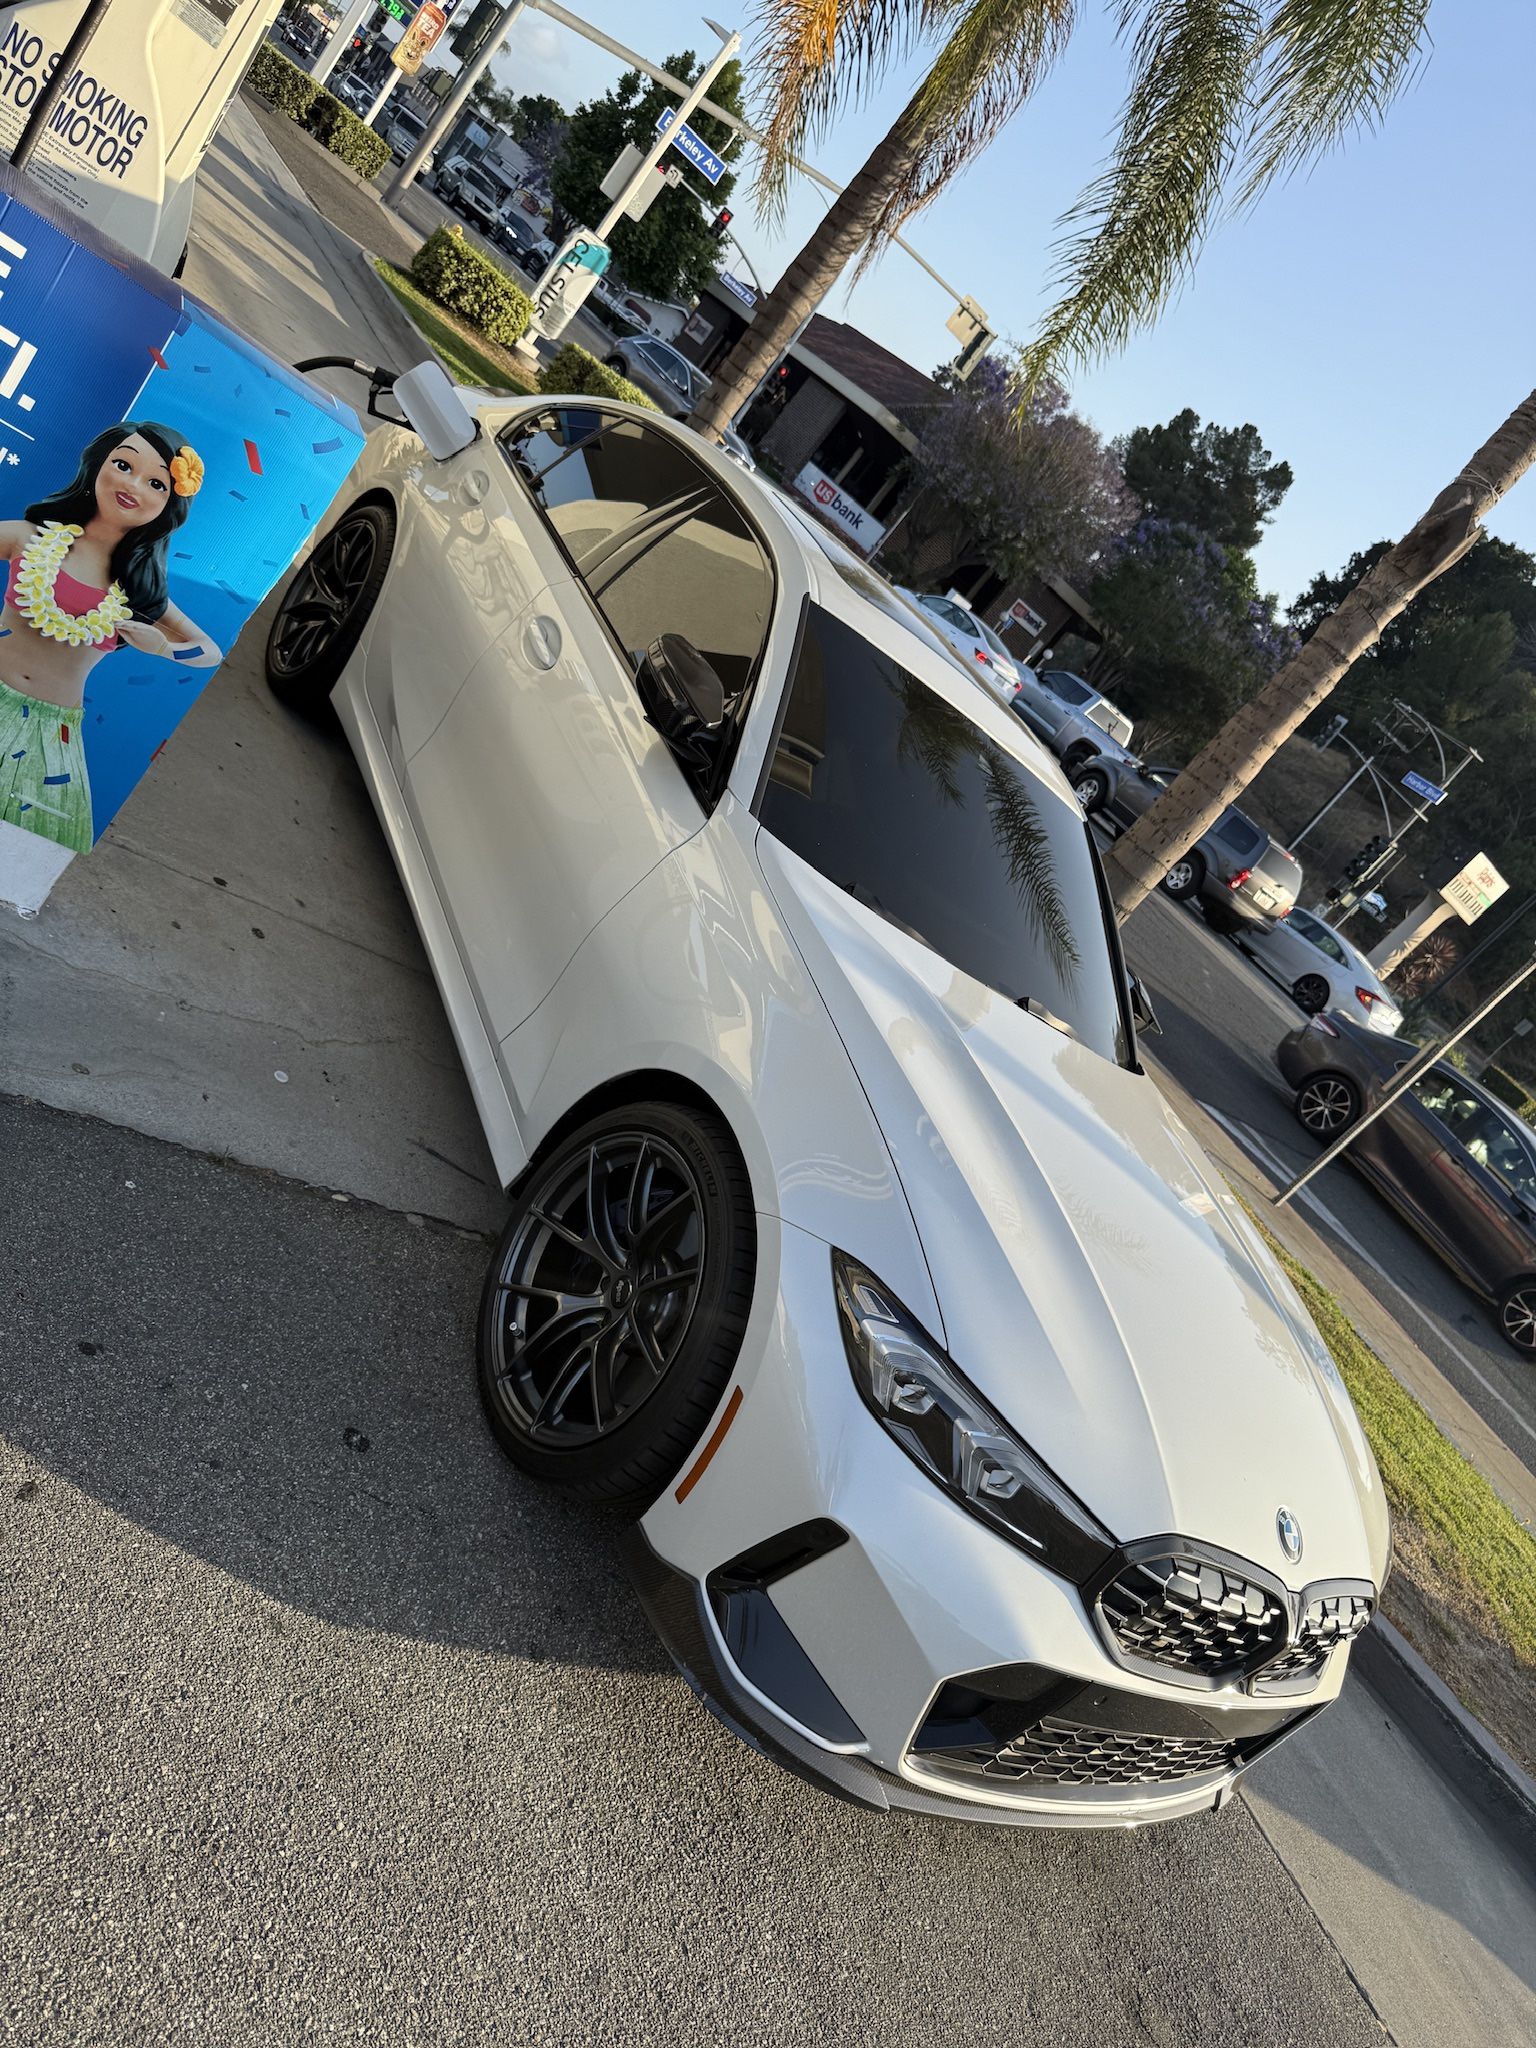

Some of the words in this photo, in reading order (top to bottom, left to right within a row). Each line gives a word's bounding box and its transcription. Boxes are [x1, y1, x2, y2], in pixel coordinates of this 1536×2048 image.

[2, 22, 43, 67] NO
[415, 18, 436, 38] TEA
[49, 101, 134, 178] MOTOR
[664, 116, 706, 162] Brkeley
[702, 155, 719, 175] Av
[52, 185, 62, 193] and
[531, 238, 590, 319] CELSIUS
[830, 495, 863, 530] bank
